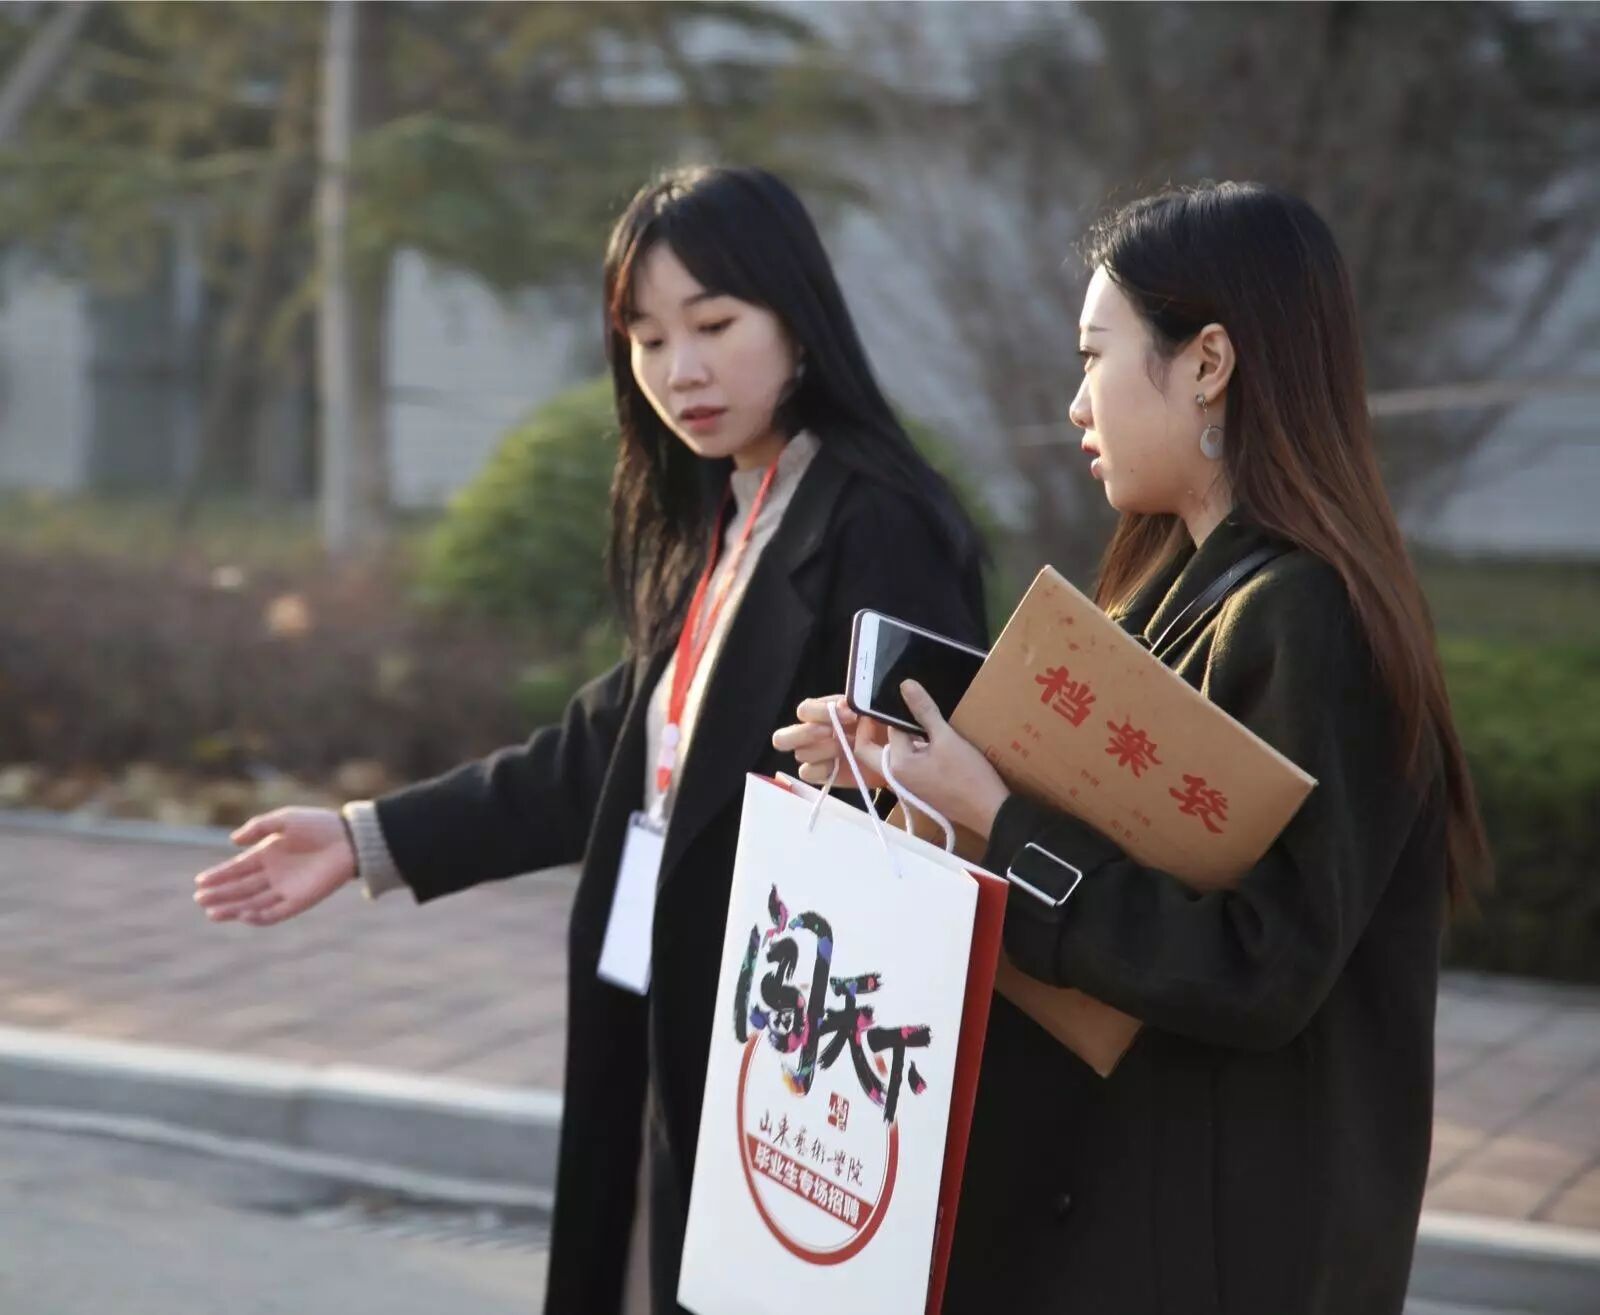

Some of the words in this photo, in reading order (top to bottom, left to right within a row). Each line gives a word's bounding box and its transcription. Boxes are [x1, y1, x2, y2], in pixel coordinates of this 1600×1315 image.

[1034, 664, 1230, 835] 档案袋
[734, 883, 932, 1123] 闯天下
[754, 1141, 860, 1225] 毕业生专场招聘
